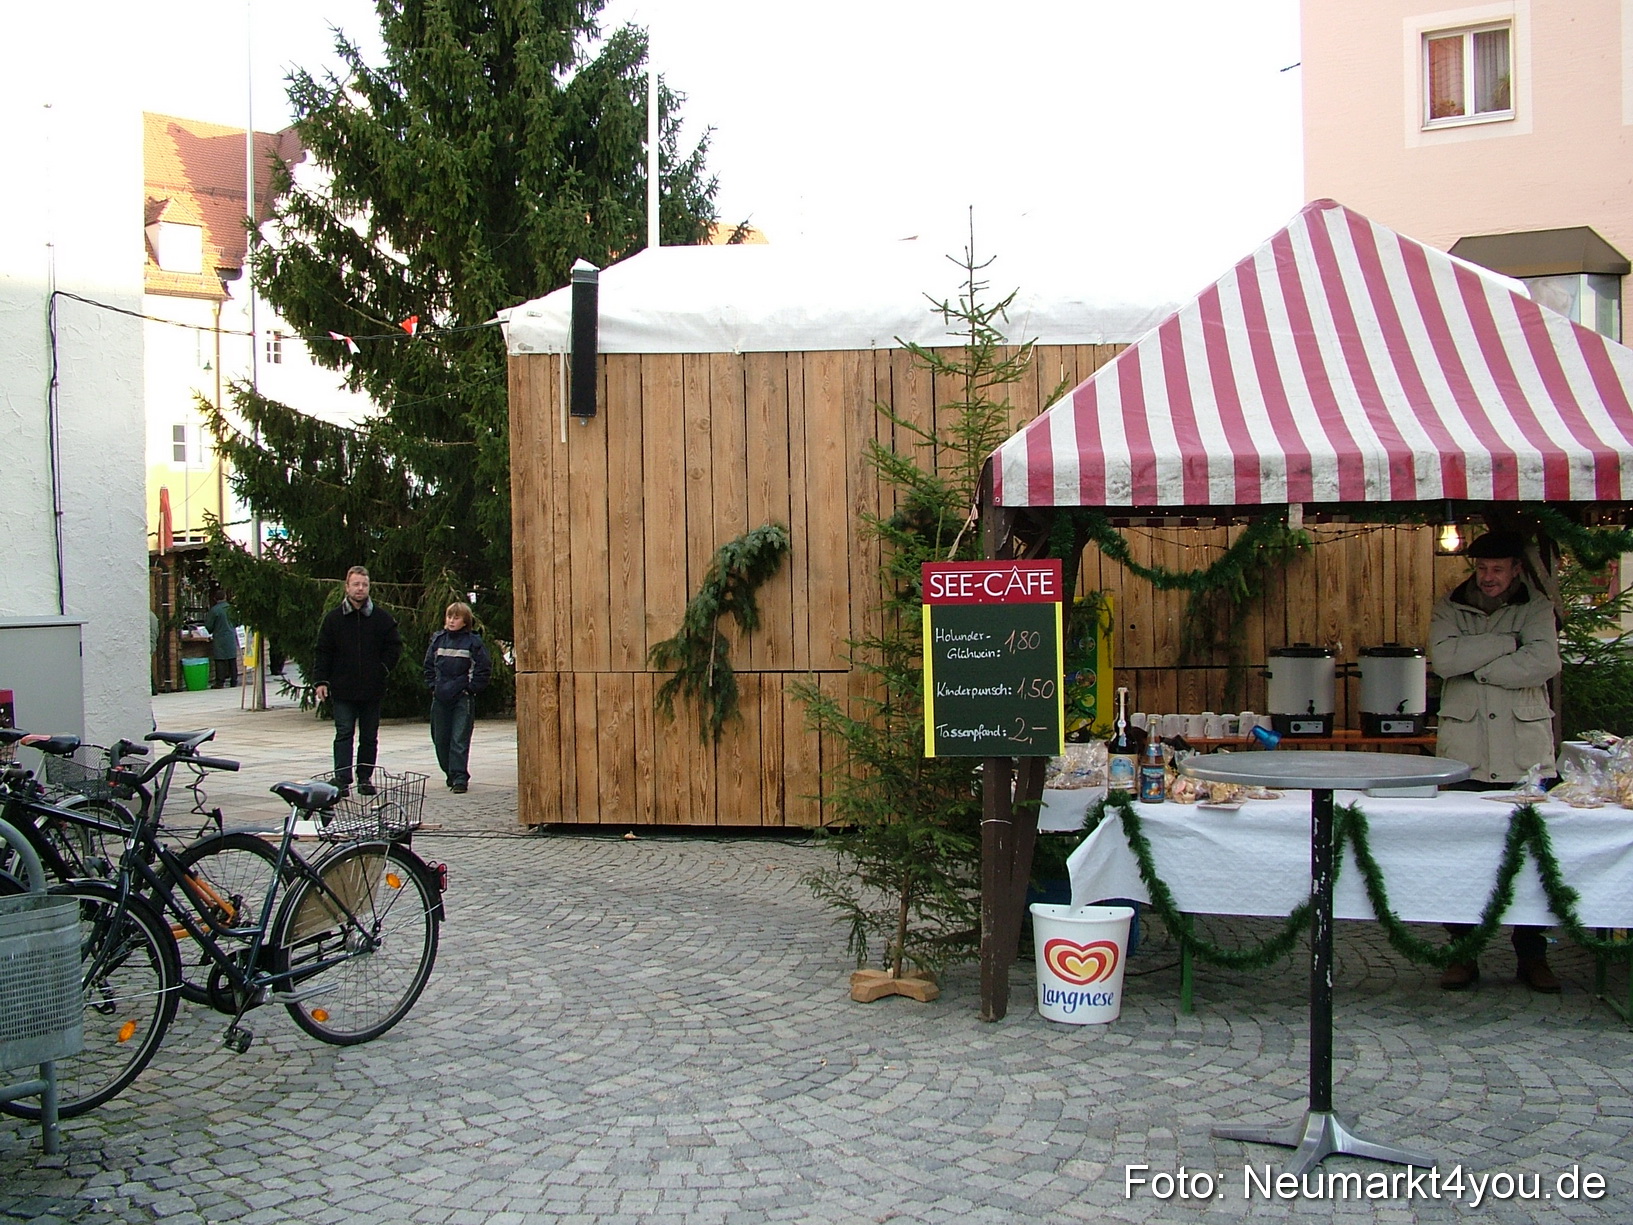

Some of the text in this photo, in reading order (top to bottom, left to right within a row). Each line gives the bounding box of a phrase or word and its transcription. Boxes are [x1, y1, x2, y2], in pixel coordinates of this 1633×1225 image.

[935, 627, 992, 643] Holunder-
[946, 629, 1041, 660] Glühwein: 1,80
[936, 677, 1055, 700] Kinderpunsch: 1,50
[935, 723, 1007, 742] Tassenpfand:
[1042, 983, 1115, 1014] Langnese
